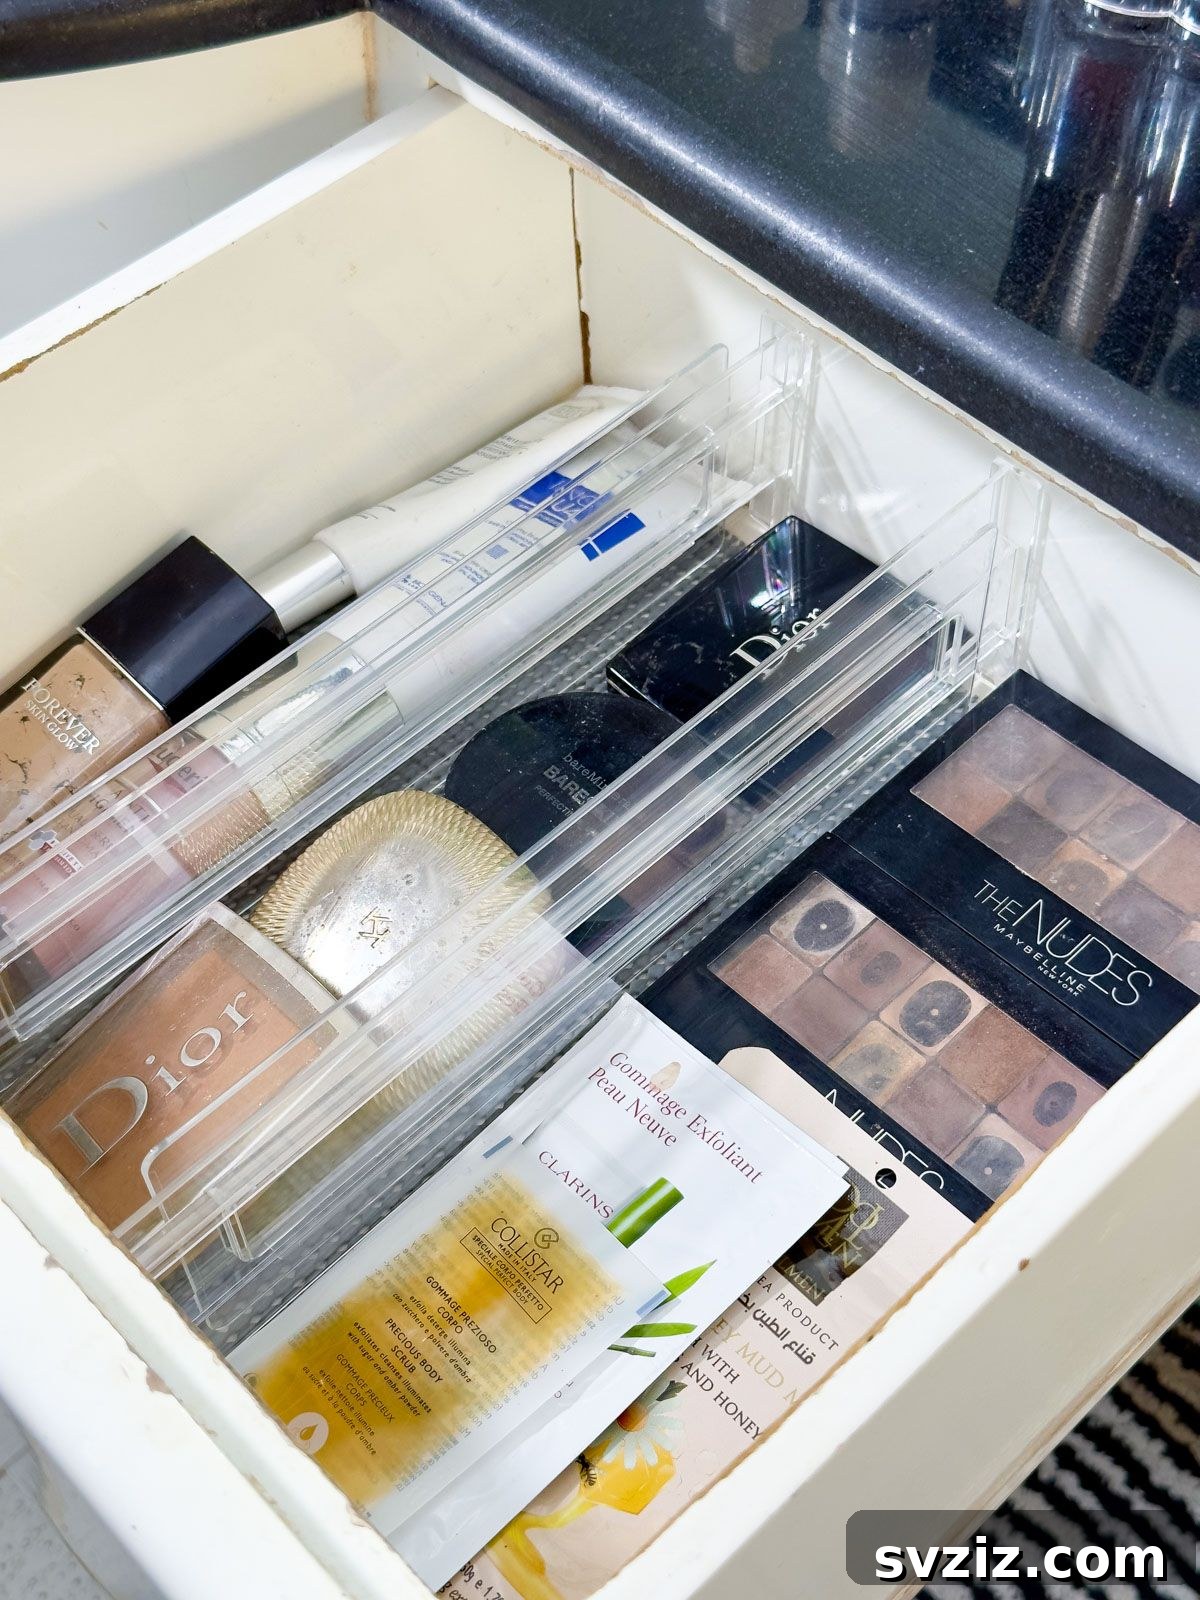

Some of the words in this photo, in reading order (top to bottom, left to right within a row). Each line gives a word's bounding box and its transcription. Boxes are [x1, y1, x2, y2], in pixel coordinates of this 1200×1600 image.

[729, 607, 832, 680] Dior
[22, 677, 100, 756] FOREVER
[25, 699, 49, 723] SKIN
[47, 722, 79, 751] GLOW
[974, 879, 1023, 922] THE
[1012, 899, 1152, 1006] NUDES
[993, 923, 1087, 993] MAYBELLINE
[1037, 965, 1057, 980] NEW
[1057, 978, 1079, 997] YORK
[51, 991, 254, 1166] Dior
[588, 1067, 626, 1104] Peau
[625, 1097, 677, 1147] Neuve
[609, 1052, 687, 1119] Gommage
[686, 1114, 763, 1184] Exfoliant
[538, 1151, 614, 1219] CLARINS
[472, 1235, 498, 1261] SPECIALE
[496, 1259, 516, 1280] CORPO
[514, 1279, 544, 1311] PERFETTO
[475, 1250, 495, 1269] SPECIAL
[493, 1268, 514, 1289] PERFECT
[512, 1287, 528, 1305] BODY
[491, 1217, 564, 1295] COLLISTAR
[498, 1243, 514, 1258] MADE
[513, 1258, 520, 1266] IN
[520, 1265, 537, 1282] ITALY
[392, 1293, 403, 1303] con
[401, 1303, 425, 1329] zucchero
[427, 1333, 450, 1358] polvere
[448, 1357, 472, 1383] d'ambra
[426, 1276, 462, 1313] GOMMAGE
[459, 1311, 497, 1353] PREZIOSO
[426, 1315, 448, 1340] deterge
[447, 1338, 471, 1366] illumina
[437, 1306, 463, 1334] CORPO
[752, 1308, 791, 1341] الطين
[756, 1275, 773, 1293] EA
[775, 1292, 839, 1351] PRODUCT
[347, 1332, 360, 1345] with
[358, 1345, 375, 1362] sugar
[373, 1362, 386, 1375] and
[383, 1375, 402, 1395] amber
[399, 1394, 421, 1418] powder
[353, 1321, 381, 1353] exfoliates
[379, 1352, 403, 1380] cleanses
[401, 1378, 432, 1414] illuminates
[385, 1318, 422, 1360] PRECIOUS
[419, 1358, 444, 1384] BODY
[390, 1345, 417, 1374] SCRUB
[701, 1344, 740, 1385] WITH
[735, 1342, 785, 1390] MUD
[782, 1340, 817, 1365] قناع
[319, 1369, 337, 1389] exfolie
[335, 1387, 355, 1412] nettoie
[353, 1410, 375, 1437] illumine
[336, 1353, 369, 1390] GOMMAGE
[366, 1388, 397, 1424] PRECIEUX
[336, 1407, 356, 1430] poudre
[345, 1382, 368, 1407] CORPS
[681, 1362, 714, 1393] AND
[713, 1391, 763, 1441] HONEY
